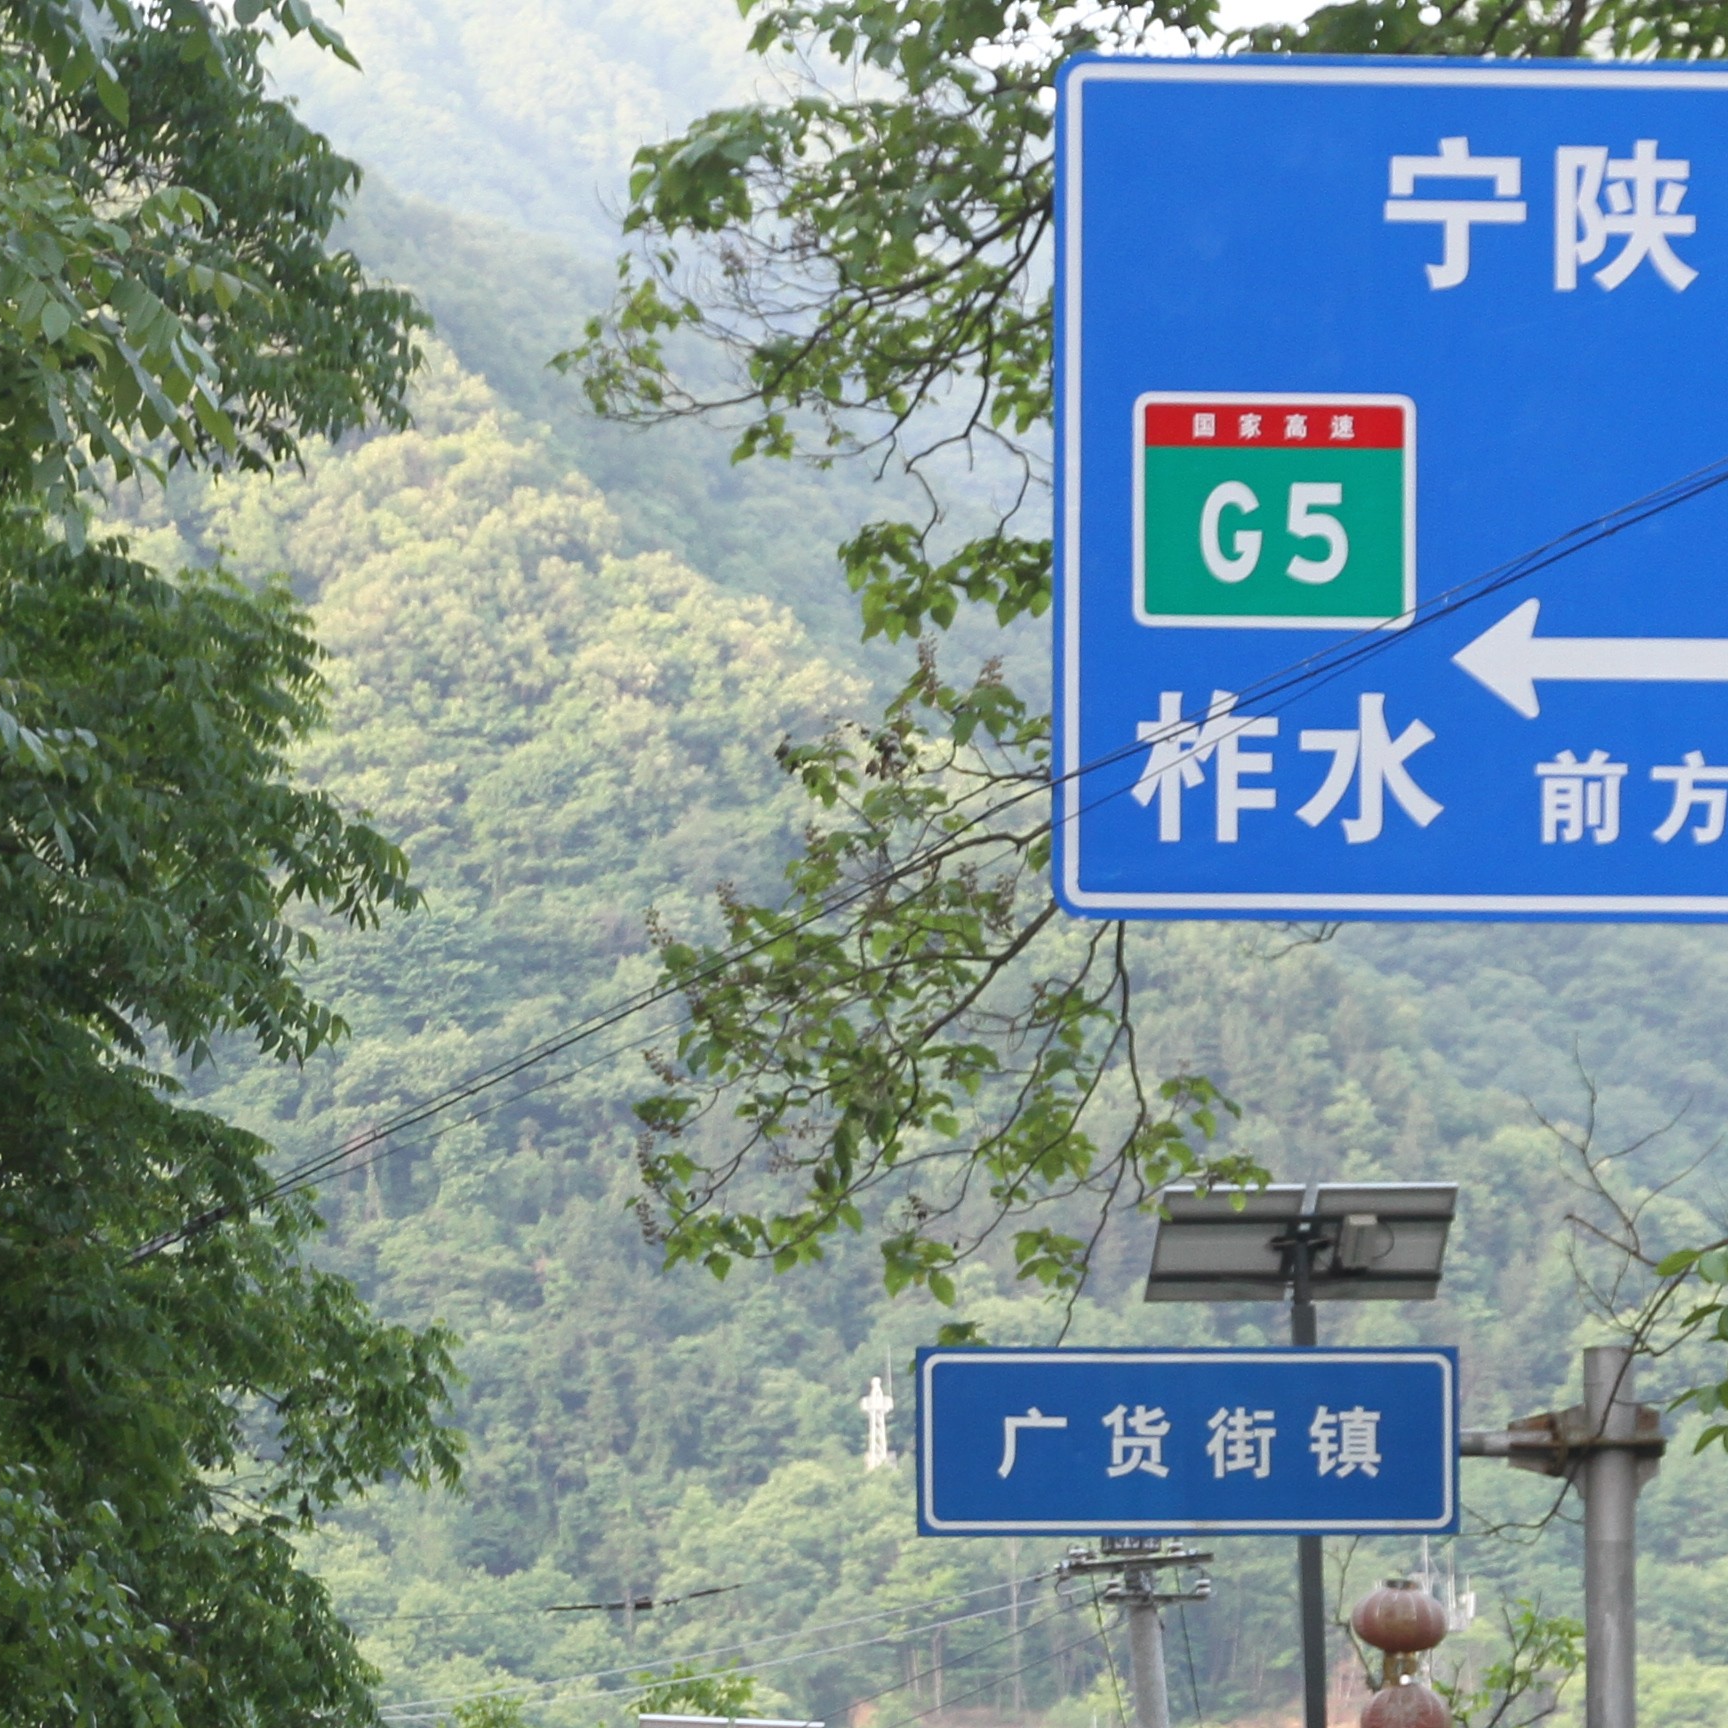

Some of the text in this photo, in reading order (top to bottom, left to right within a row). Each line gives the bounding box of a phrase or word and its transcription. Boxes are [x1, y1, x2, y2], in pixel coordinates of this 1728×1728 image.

[1384, 138, 1698, 291] 宁陕
[1192, 412, 1355, 439] 国家高速
[1199, 482, 1350, 583] G5
[1130, 690, 1443, 843] 柞水
[997, 1405, 1382, 1479] 广货街镇
